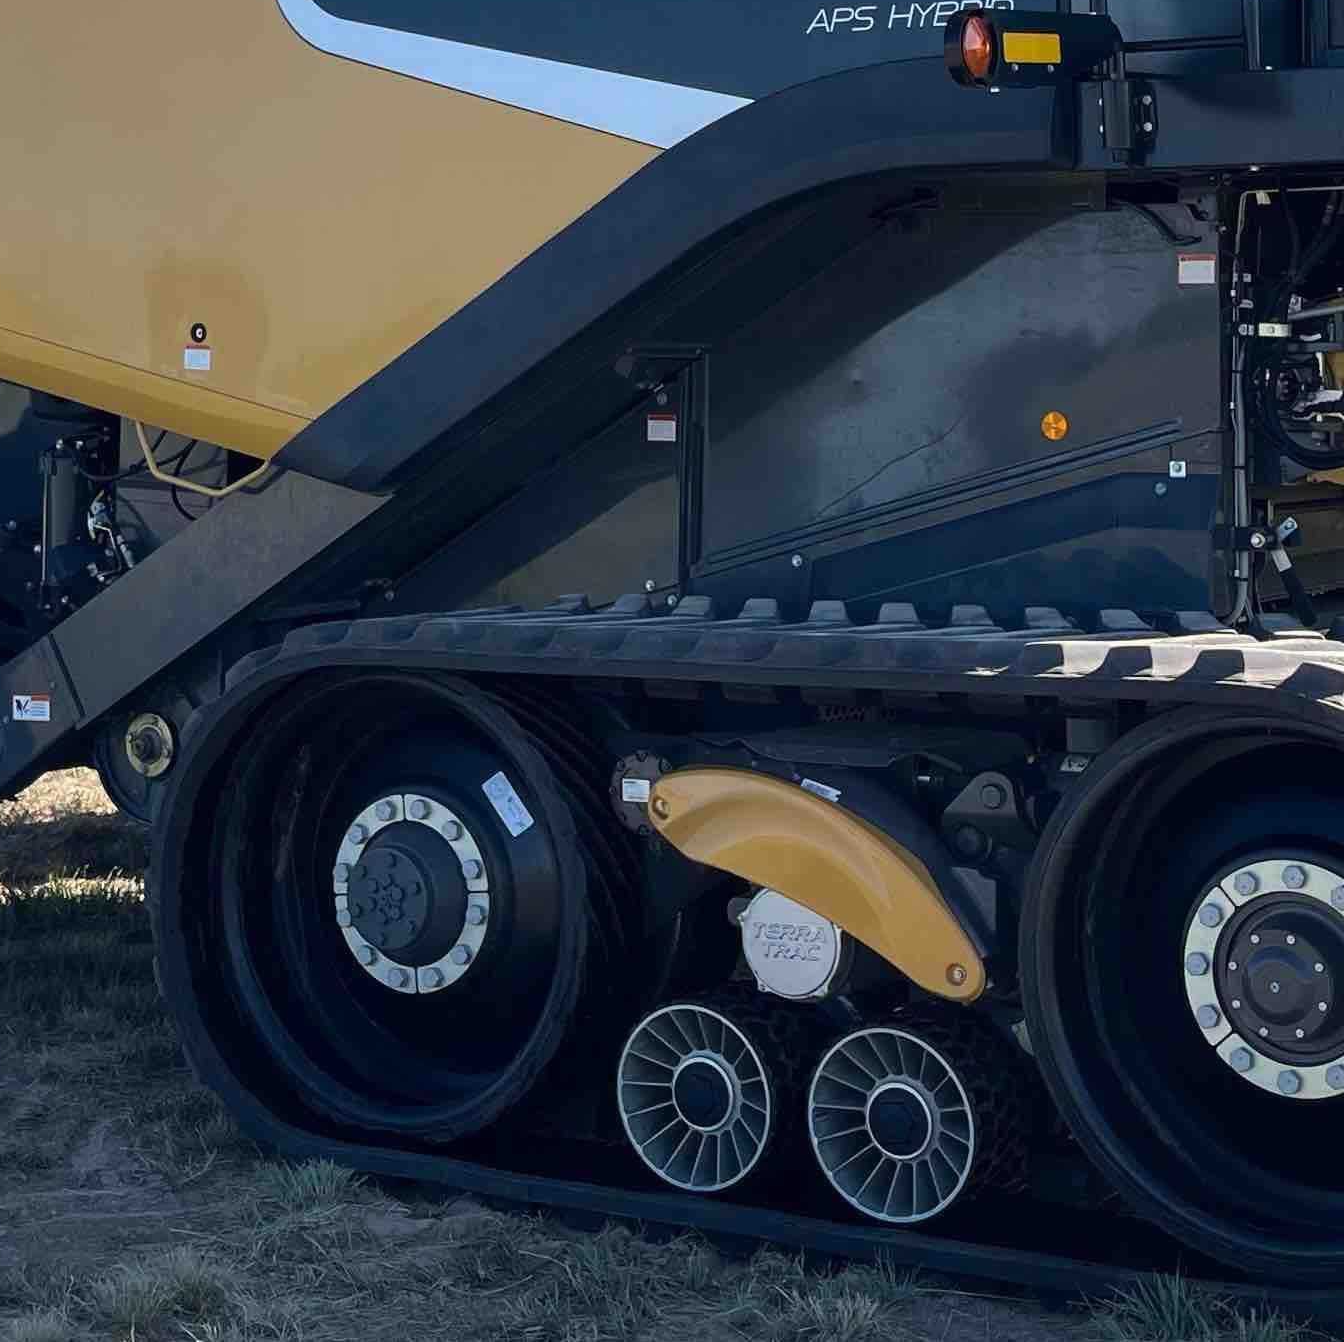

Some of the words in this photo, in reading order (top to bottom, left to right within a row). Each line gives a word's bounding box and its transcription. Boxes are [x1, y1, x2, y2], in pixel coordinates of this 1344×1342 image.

[806, 6, 877, 34] APS
[753, 922, 827, 944] TERRA
[763, 942, 821, 962] TRAC
